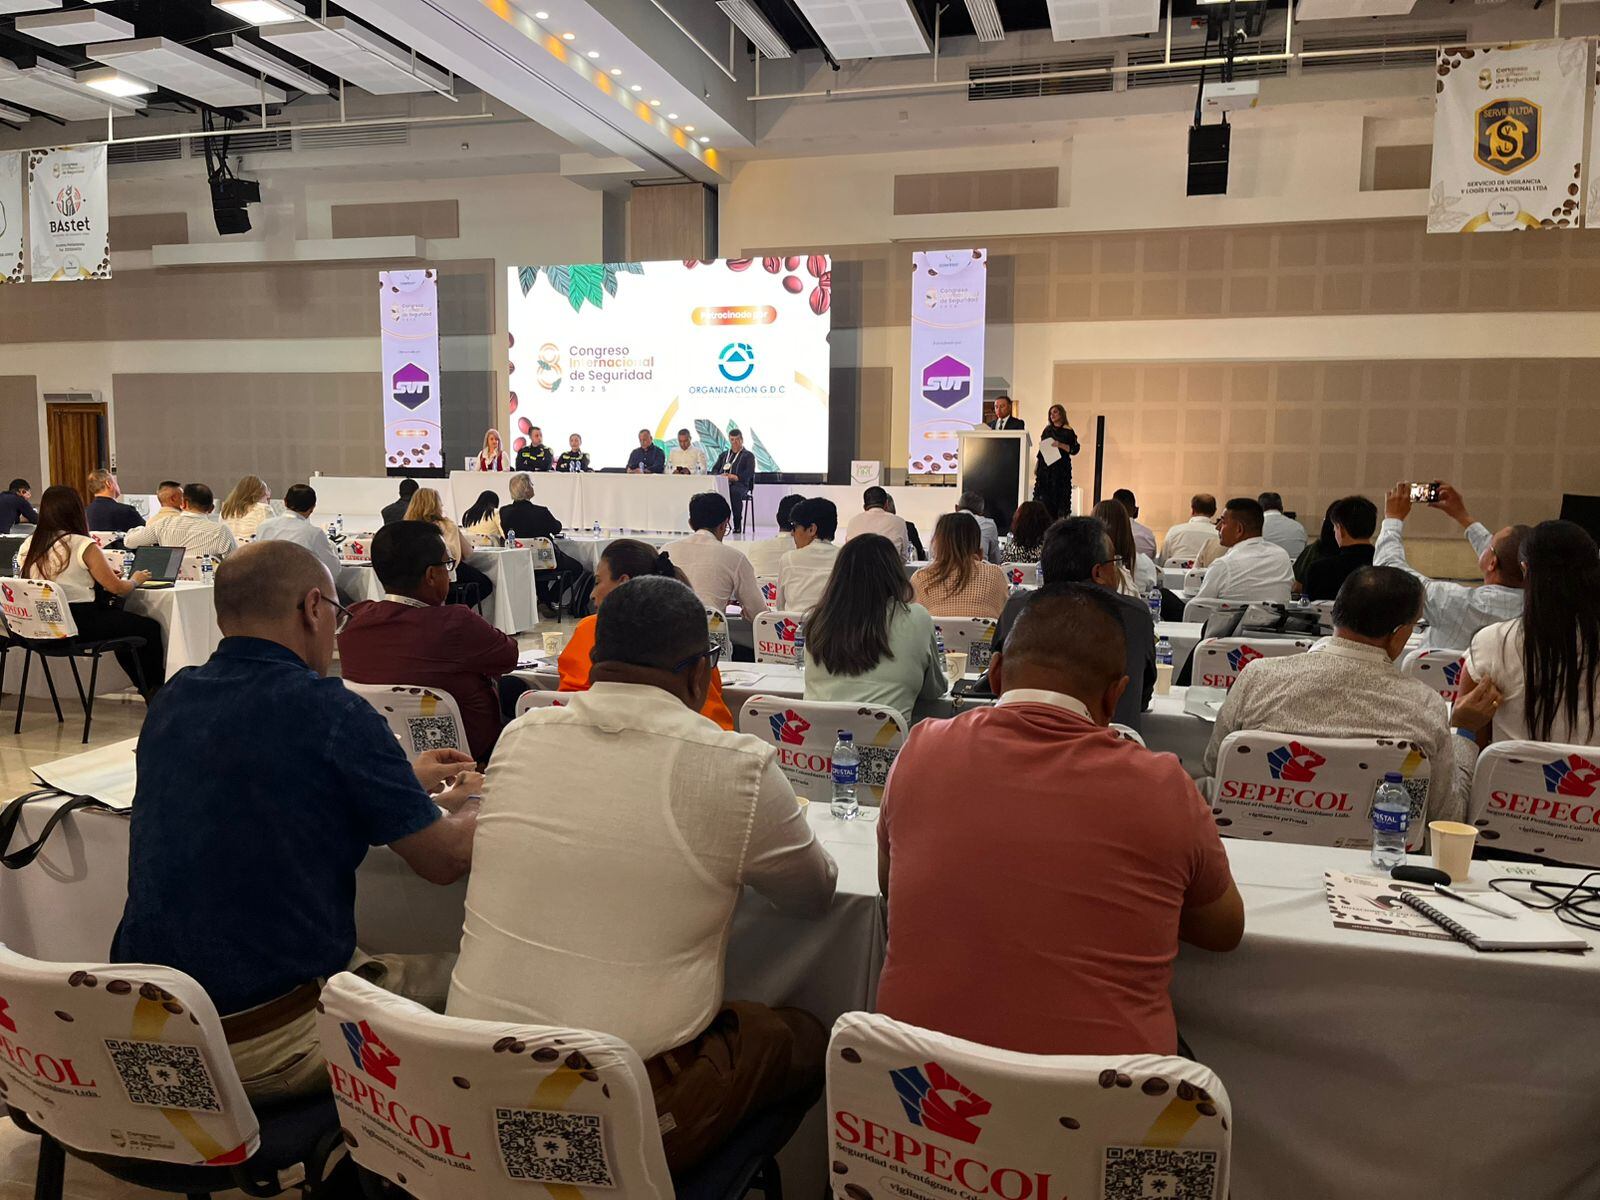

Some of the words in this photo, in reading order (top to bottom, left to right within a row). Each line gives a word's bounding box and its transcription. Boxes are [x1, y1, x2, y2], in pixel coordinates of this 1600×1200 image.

[1497, 120, 1517, 156] S
[50, 216, 91, 233] BAstet
[569, 345, 630, 359] Congreso
[569, 357, 654, 367] Inernacioal
[569, 370, 585, 381] de
[588, 369, 653, 384] Seguridad
[688, 386, 758, 394] ORGANIZACIÓN
[759, 640, 797, 656] SEPEC
[777, 748, 832, 773] ECOL
[1221, 780, 1353, 812] SEPECOL
[1219, 798, 1252, 807] Seguridad
[1258, 802, 1293, 812] Pentágono
[1293, 807, 1334, 817] Colombiano
[1488, 790, 1600, 826] SEPEC
[1248, 812, 1280, 821] vigilancia
[1280, 815, 1308, 825] privada
[1569, 824, 1600, 833] Colombi
[0, 1034, 97, 1087] ECOL
[835, 1110, 1068, 1200] SEPECOL
[835, 1141, 887, 1168] Seguridad
[889, 1163, 899, 1174] el
[901, 1166, 958, 1195] Pentágono
